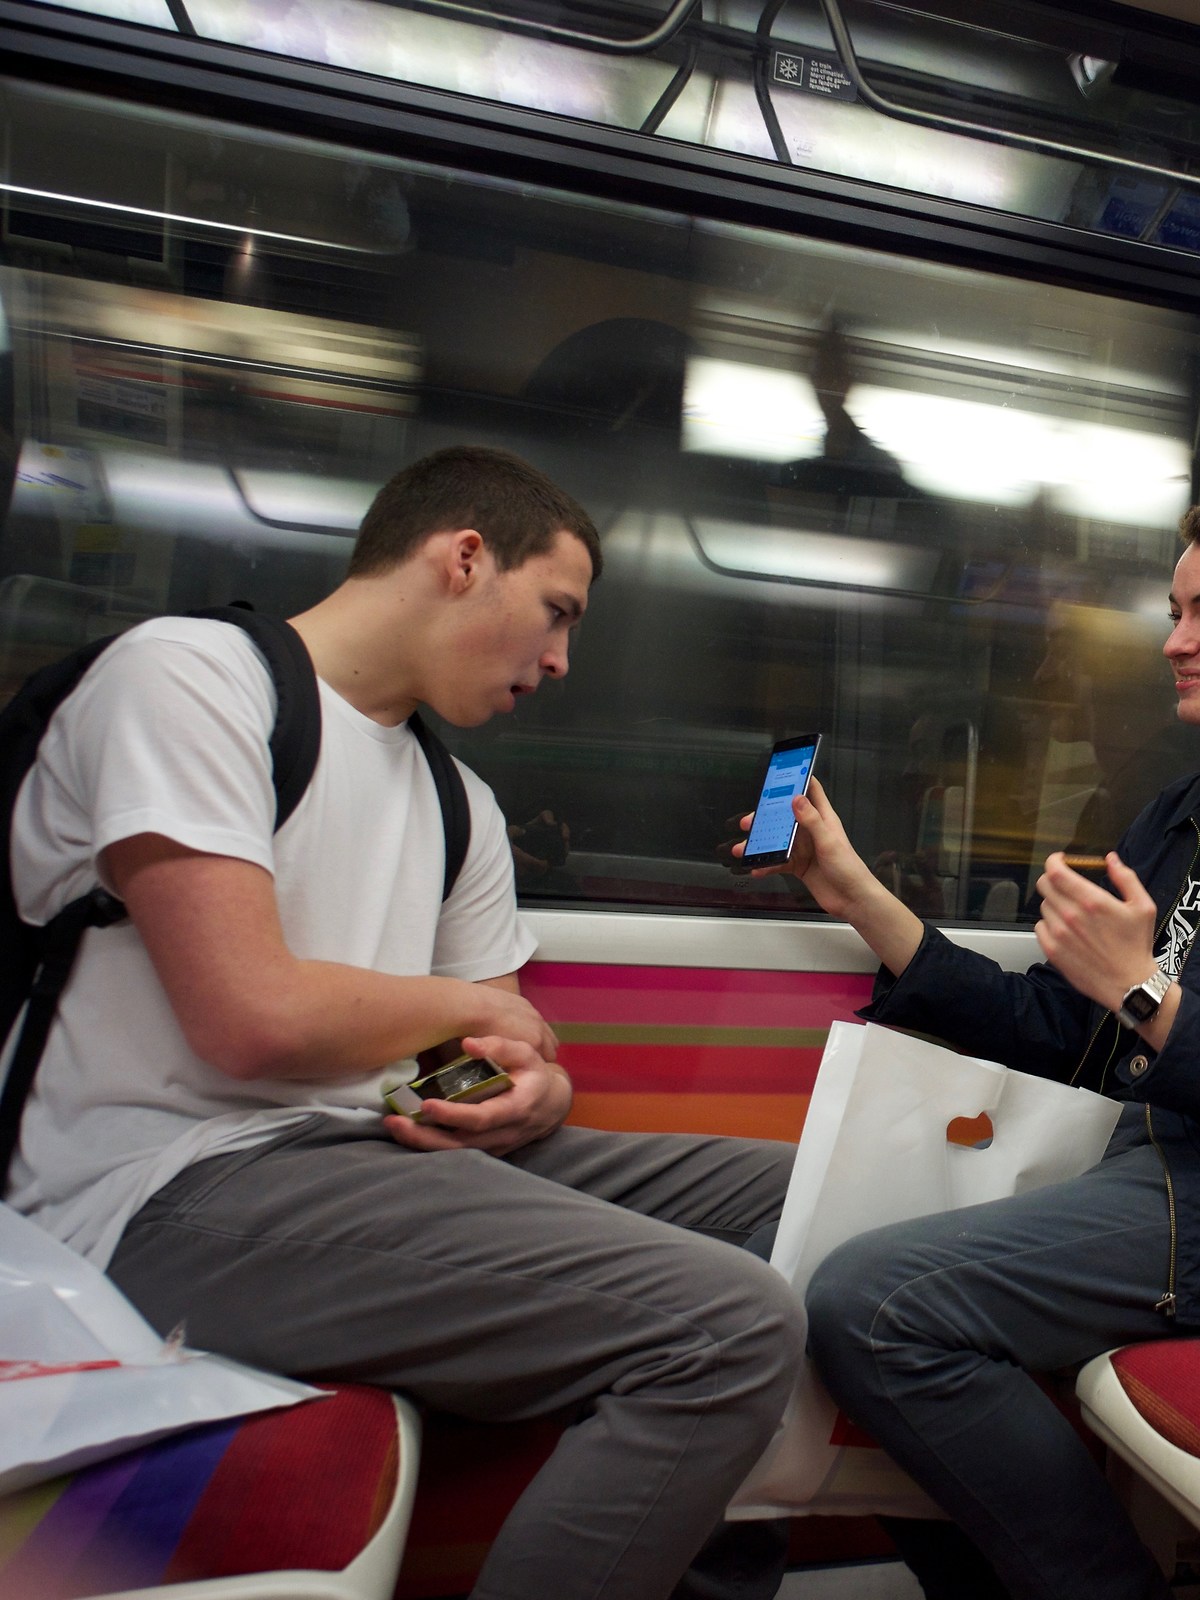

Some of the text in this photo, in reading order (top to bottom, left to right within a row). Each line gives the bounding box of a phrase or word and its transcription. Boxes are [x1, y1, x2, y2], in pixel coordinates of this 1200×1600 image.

[819, 62, 832, 70] train
[810, 72, 825, 80] Merci
[834, 78, 851, 86] garder
